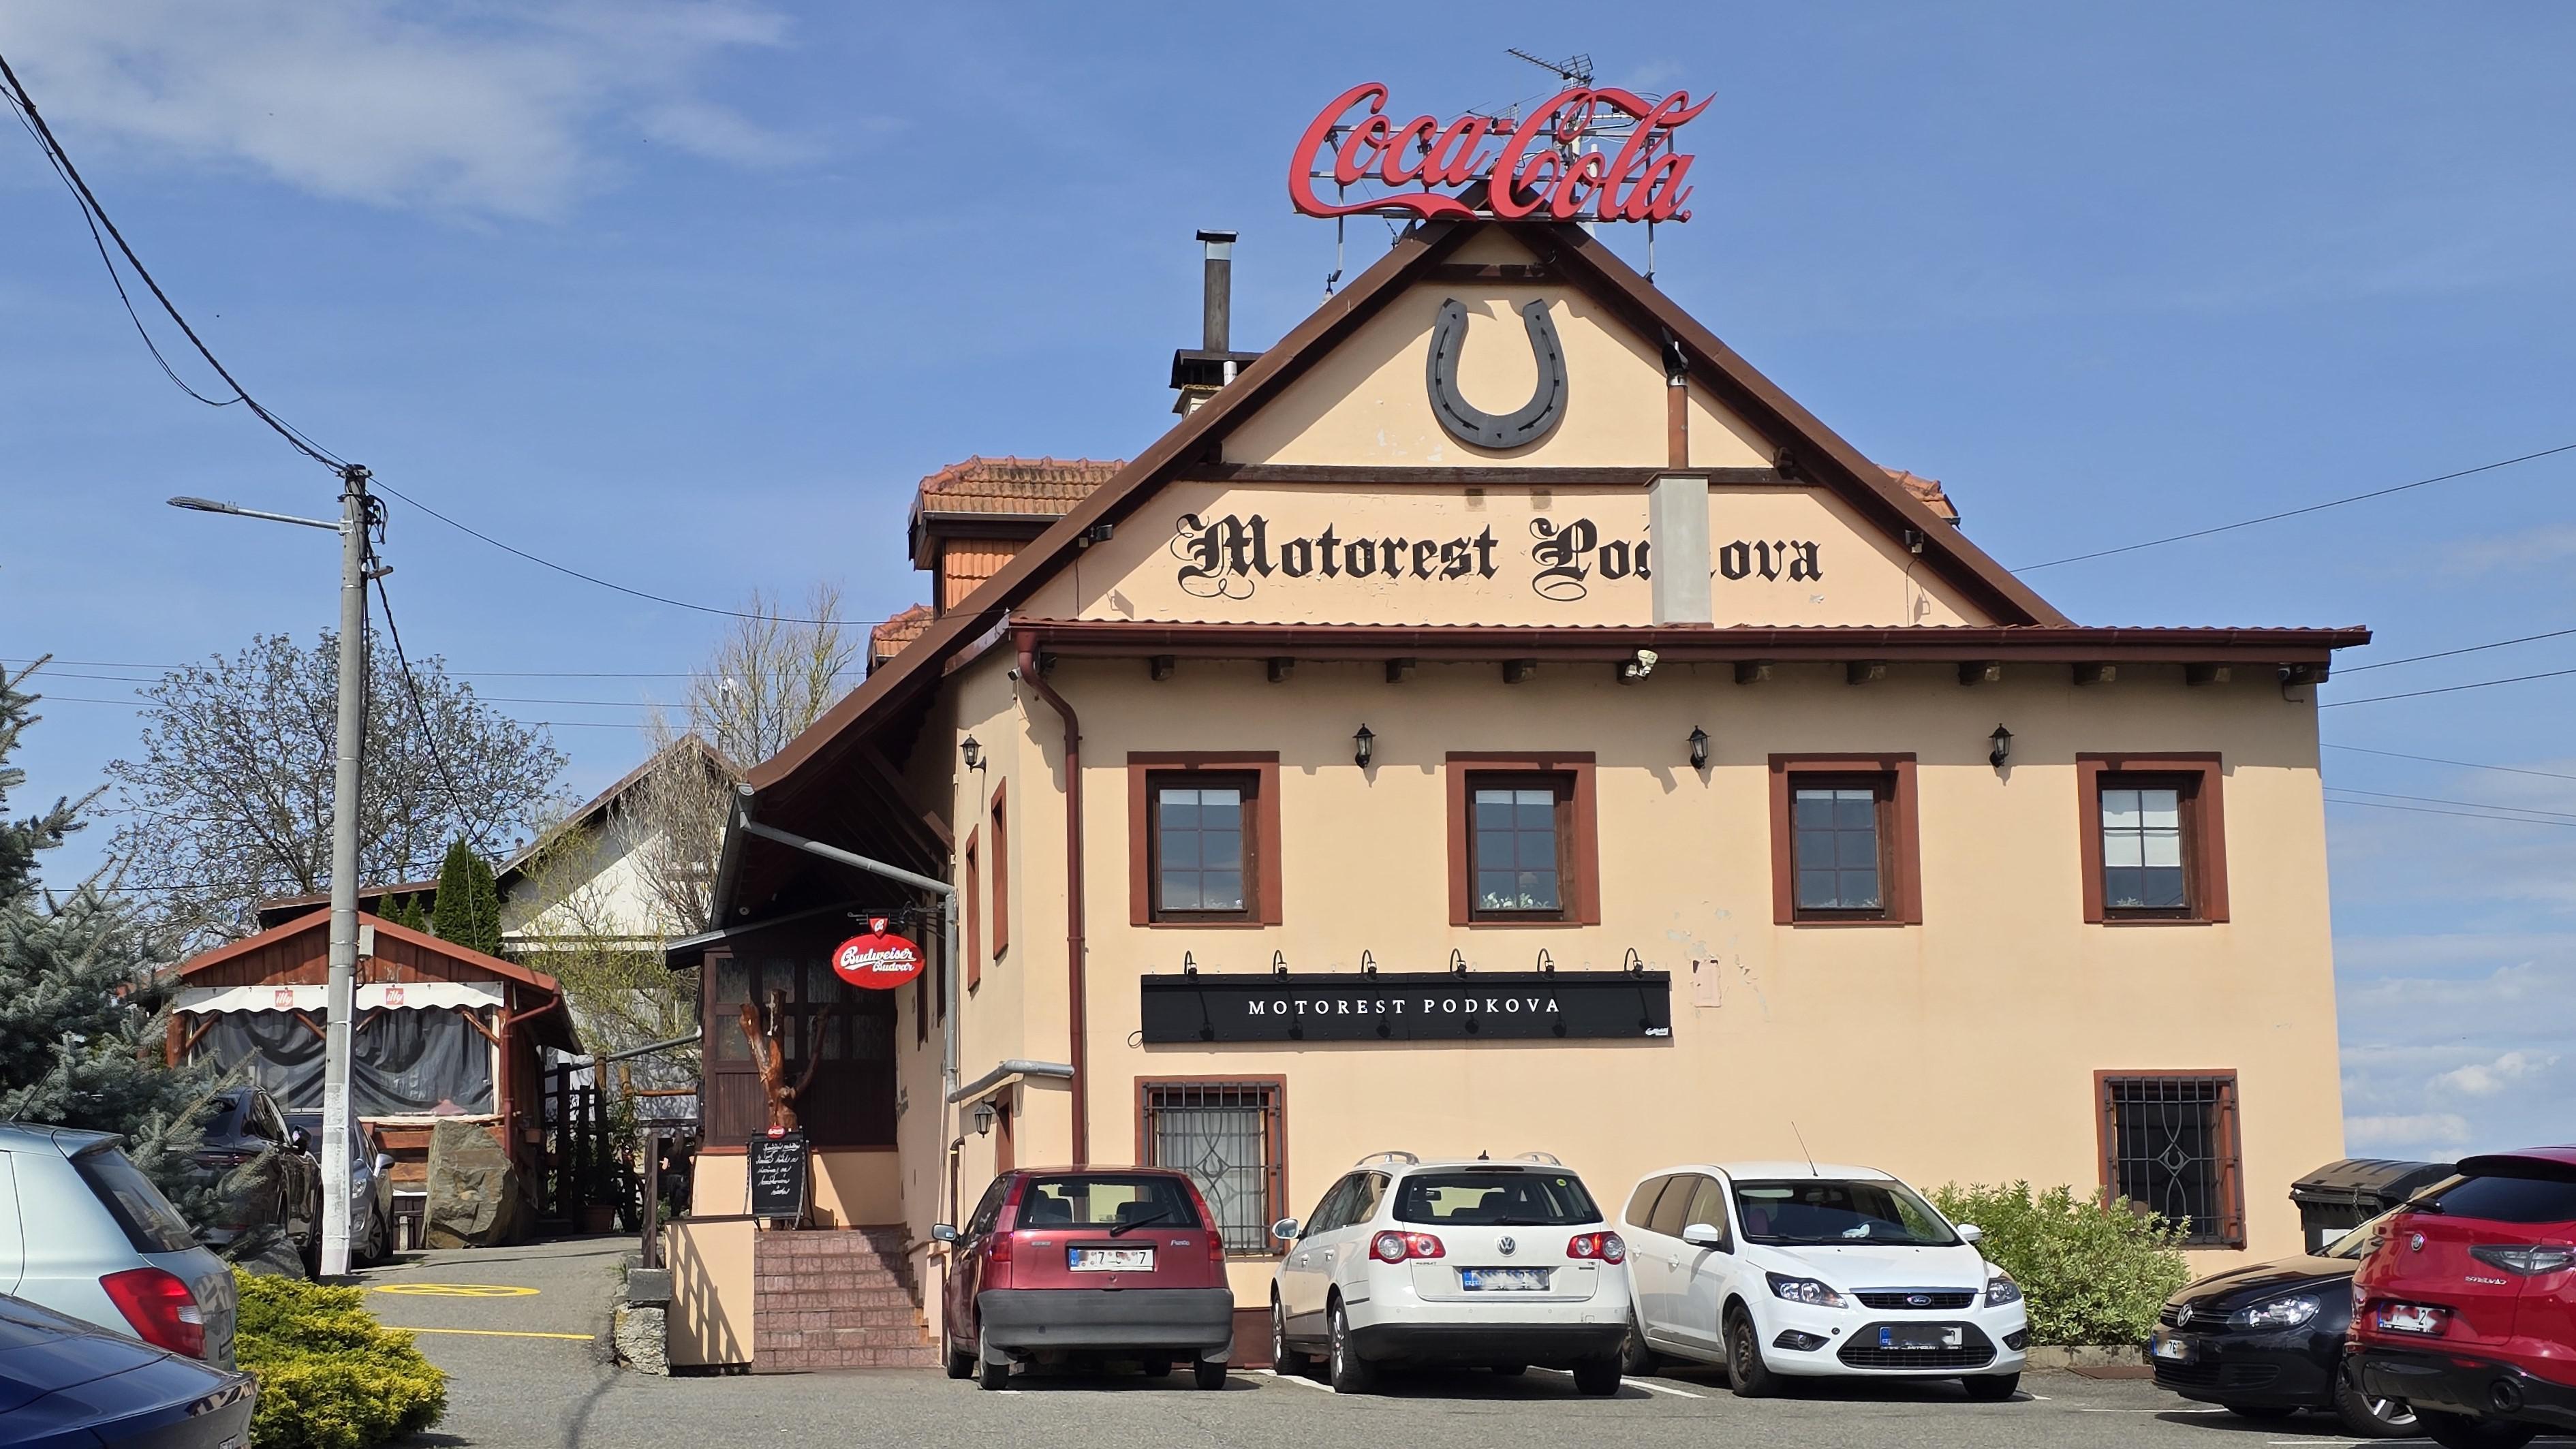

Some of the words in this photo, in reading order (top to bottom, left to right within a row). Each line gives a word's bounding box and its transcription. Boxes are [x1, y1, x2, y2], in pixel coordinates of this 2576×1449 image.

[1288, 82, 1717, 223] Coca-Cola
[1170, 513, 1500, 600] Motorest
[840, 946, 916, 970] Budweiser
[873, 960, 915, 972] Budvar
[276, 993, 292, 1006] illy
[387, 990, 403, 1003] illy
[1248, 999, 1406, 1014] MOTOREST
[1424, 998, 1559, 1013] PODKOVA
